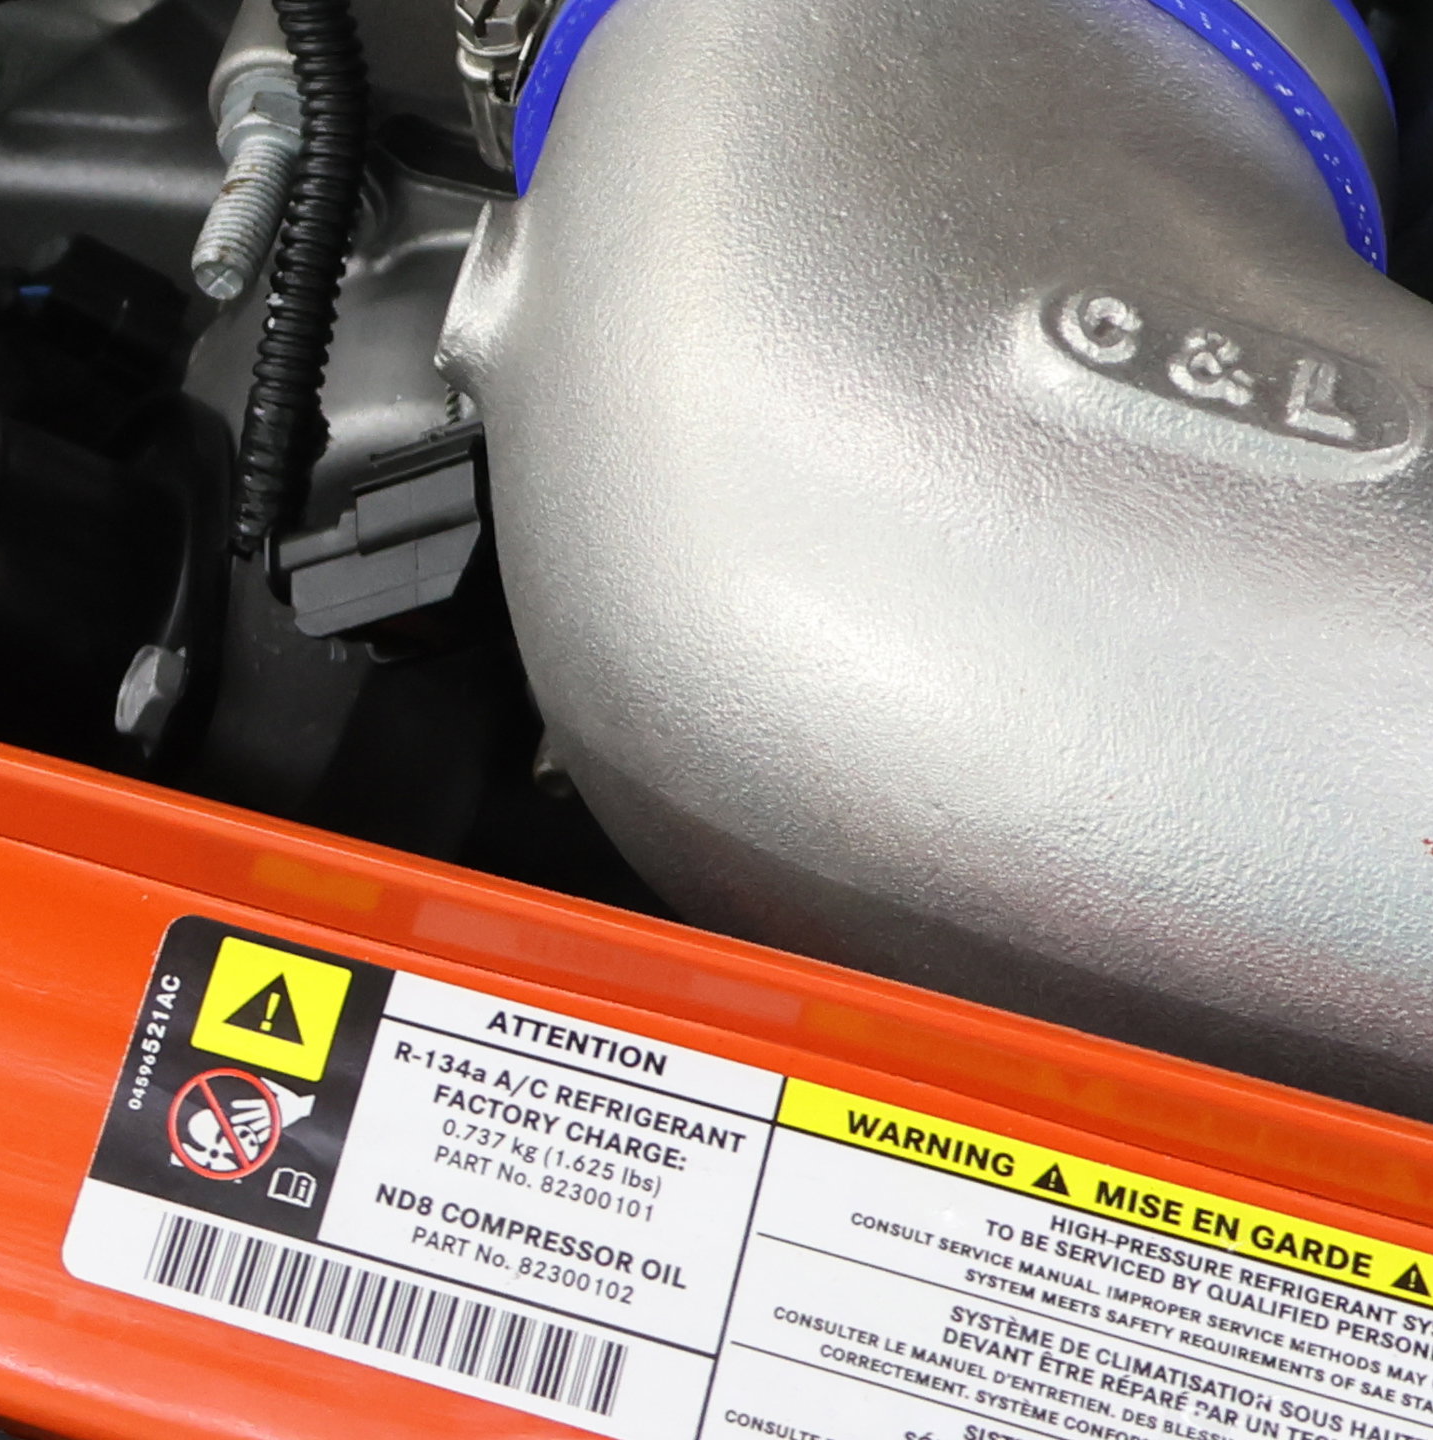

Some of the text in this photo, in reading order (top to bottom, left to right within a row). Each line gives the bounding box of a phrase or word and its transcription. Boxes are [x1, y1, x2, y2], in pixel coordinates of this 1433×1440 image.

[1285, 358, 1357, 441] L
[127, 973, 182, 1111] 04596521AC
[394, 1040, 747, 1153] R-134a A/C REFRIGERANT
[486, 1010, 667, 1077] ATTENTION
[433, 1083, 687, 1171] FACTORY CHARGE:
[442, 1118, 662, 1199] 0.737 kg (1.625 lbs)
[375, 1183, 687, 1290] ND8 COMPRESSOR OIL
[434, 1144, 653, 1222] PART No. 82300101
[848, 1109, 1015, 1178] WARNING
[1094, 1180, 1184, 1226] MISE
[1192, 1207, 1240, 1242] EN
[1250, 1224, 1373, 1279] GARDE
[411, 1225, 634, 1305] PART No. 82300102
[850, 1212, 935, 1246] CONSULT
[938, 1237, 1014, 1270] SERVICE
[1106, 1285, 1202, 1324] IMPROPER
[1206, 1314, 1285, 1348] SERVICE
[1289, 1337, 1382, 1375] METHODS
[1386, 1364, 1428, 1387] MAY
[986, 1219, 1015, 1242] TO
[1020, 1230, 1050, 1252] BE
[1054, 1240, 1166, 1284] SERVICED
[1171, 1272, 1202, 1294] BY
[1206, 1283, 1330, 1330] QUALIFIED
[1050, 1215, 1233, 1281] HIGH-PRESSURE
[1239, 1268, 1398, 1326] REFRIGERANT
[773, 1306, 880, 1348] CONSULTER
[884, 1338, 907, 1356] LE
[910, 1345, 987, 1380] MANUEL
[1121, 1408, 1158, 1430] DES
[820, 1344, 969, 1399] CORRECTEMENT.
[974, 1389, 1060, 1426] SYSTÈME
[942, 1326, 1035, 1367] DEVANT
[1038, 1351, 1095, 1386] ÊTRE
[1100, 1373, 1189, 1412] RÉPARÉ
[1245, 1415, 1280, 1440] UN
[950, 1305, 1055, 1355] SYSTÈME
[1059, 1336, 1091, 1360] DE
[1095, 1347, 1273, 1413] CLIMATISATION
[1279, 1400, 1344, 1433] SOUS
[964, 1268, 1036, 1300] SYSTEM
[1040, 1290, 1101, 1319] MEETS
[1105, 1309, 1175, 1339] SAFETY
[1179, 1330, 1325, 1383] REQUIREMENTS
[1330, 1373, 1356, 1390] OF
[1360, 1381, 1396, 1403] SAE
